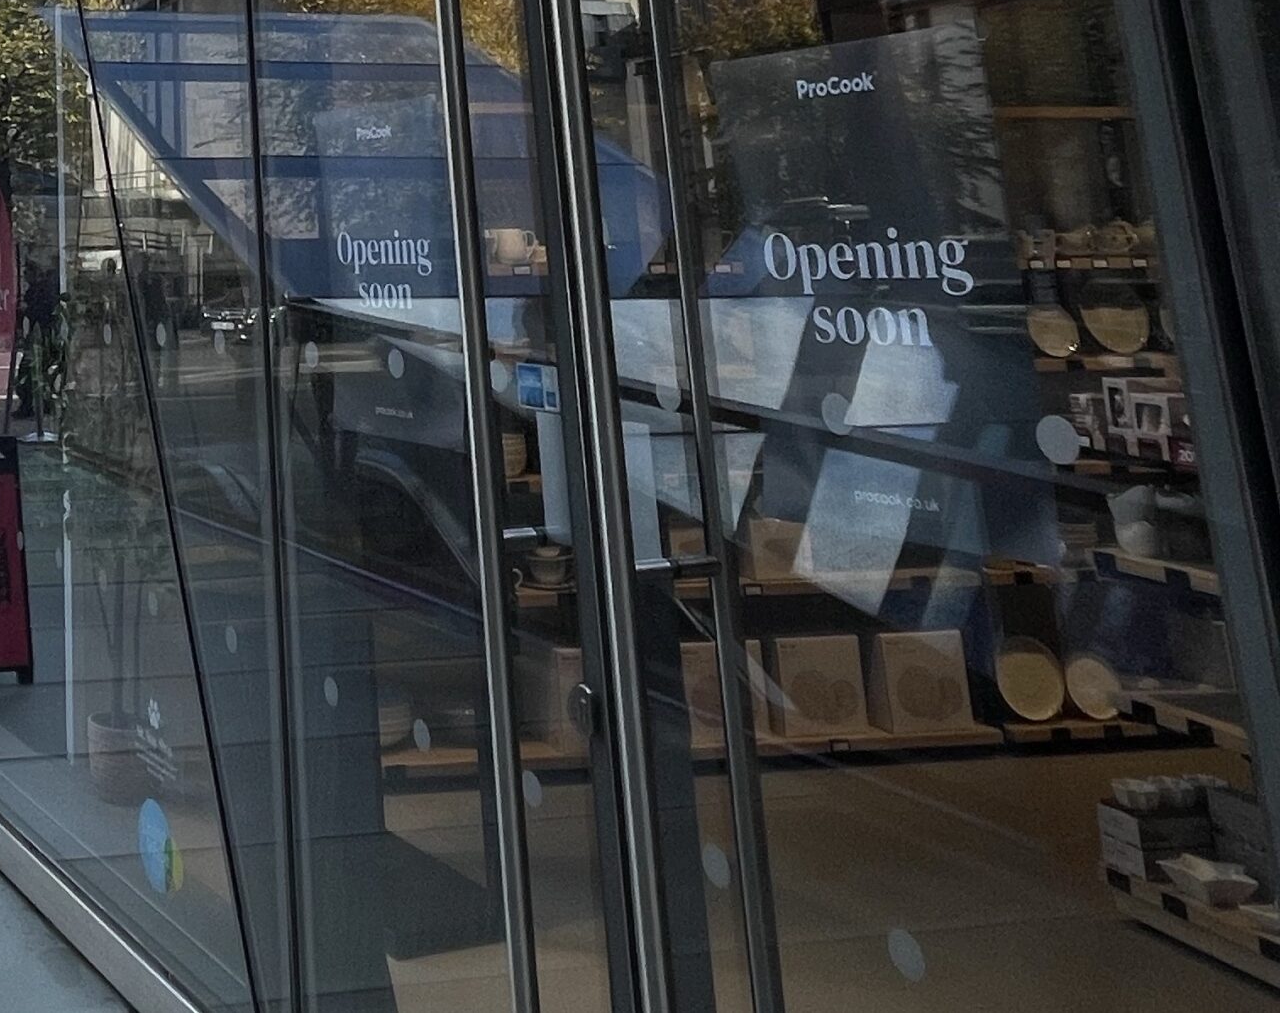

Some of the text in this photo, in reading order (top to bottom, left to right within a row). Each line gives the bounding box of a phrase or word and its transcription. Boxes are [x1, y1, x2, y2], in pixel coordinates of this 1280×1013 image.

[796, 72, 875, 99] ProCook
[356, 125, 391, 140] ProCook
[337, 230, 432, 276] Opening
[764, 227, 974, 296] Opening
[359, 282, 413, 310] soon
[812, 306, 933, 347] soon
